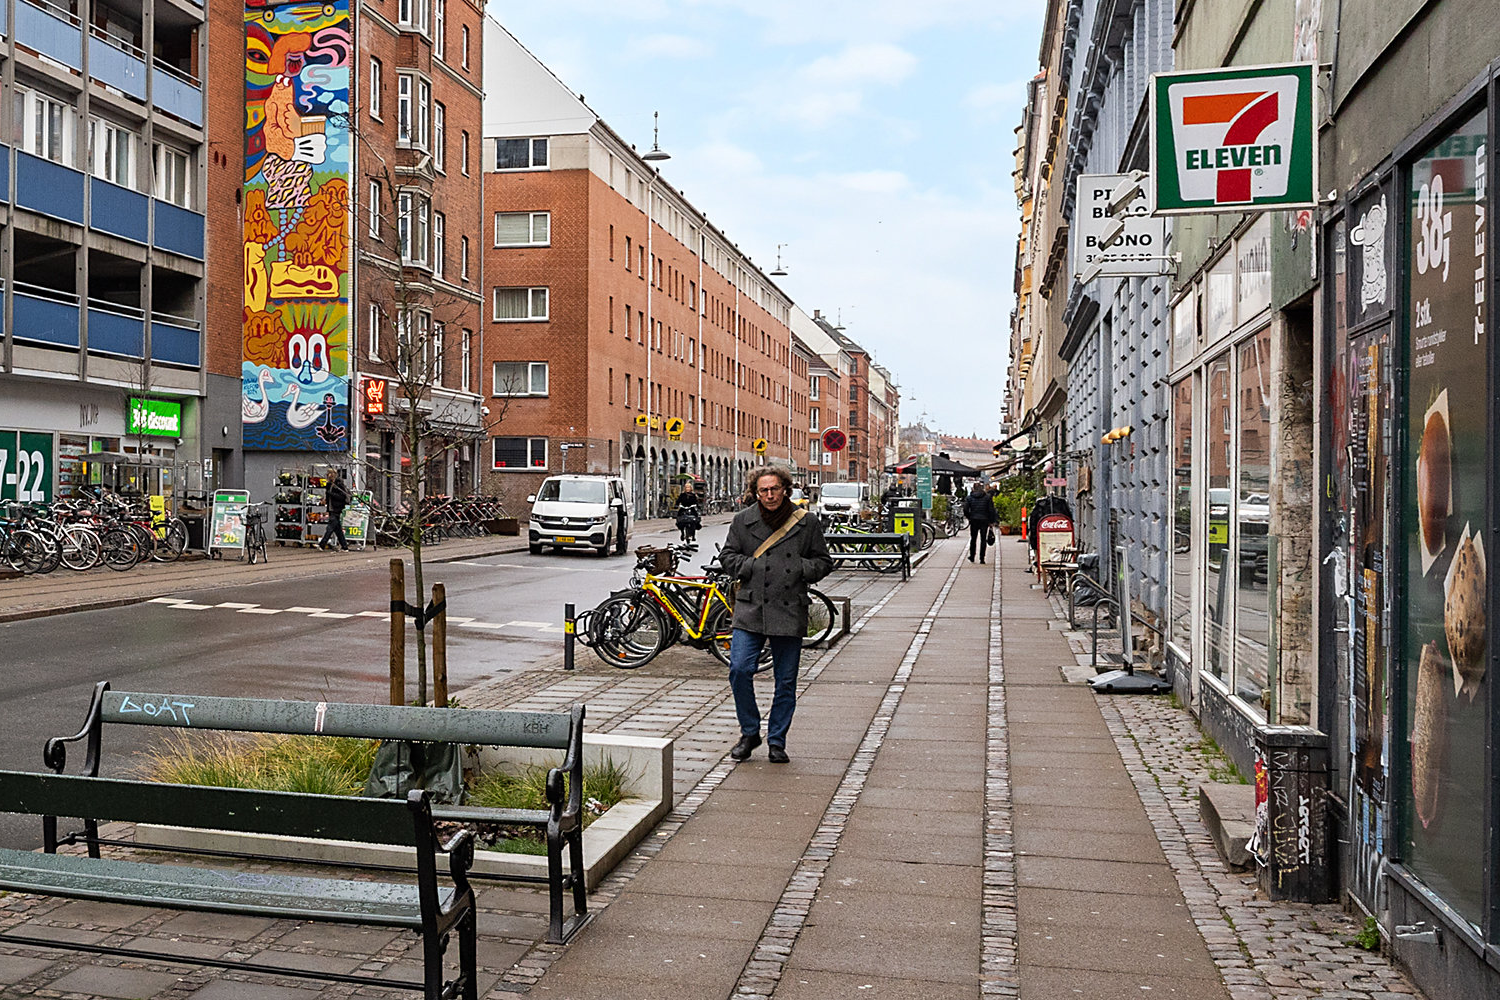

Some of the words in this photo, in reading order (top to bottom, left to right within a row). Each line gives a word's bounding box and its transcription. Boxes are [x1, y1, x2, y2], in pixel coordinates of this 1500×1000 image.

[1182, 91, 1279, 203] 7
[1093, 188, 1146, 200] PIA
[1086, 234, 1152, 247] BONO
[523, 723, 549, 734] KBH
